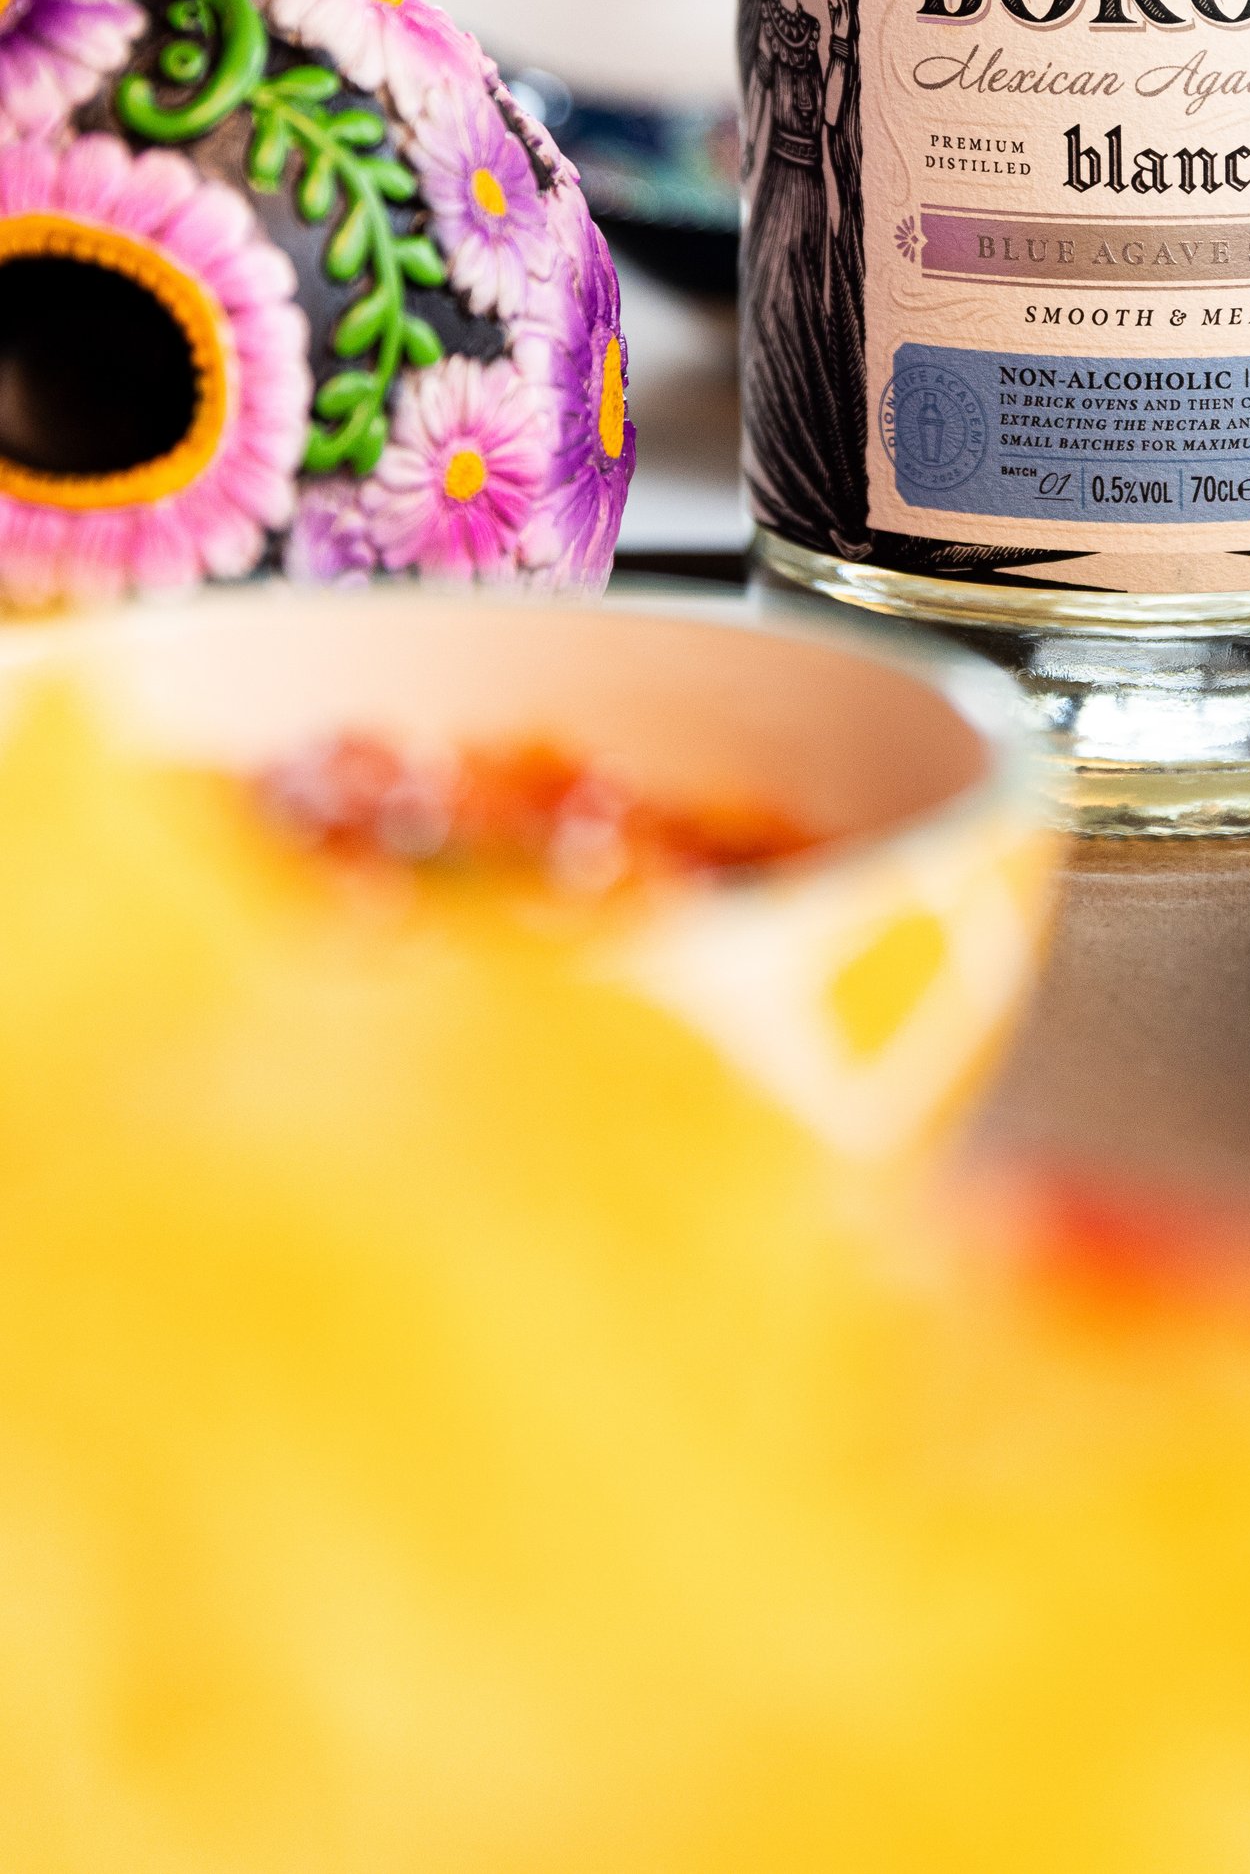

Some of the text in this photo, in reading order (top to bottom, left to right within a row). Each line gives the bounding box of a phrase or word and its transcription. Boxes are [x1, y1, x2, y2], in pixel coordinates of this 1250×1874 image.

[913, 44, 1125, 97] Mexican
[930, 134, 1025, 154] PREMIUM
[925, 155, 1031, 176] DISTILLED
[977, 234, 1076, 264] BLUE
[1092, 239, 1231, 266] AGAVE
[1024, 305, 1154, 327] SMOOTH
[1169, 308, 1187, 327] &
[999, 366, 1232, 391] NON-ALCOHOLIC
[1000, 393, 1017, 406] IN
[1023, 395, 1076, 410] BRICK
[1082, 398, 1138, 411] OVENS
[1144, 399, 1181, 411] AND
[1188, 397, 1235, 411] THEN
[935, 374, 982, 459] ACADEMY
[1000, 413, 1107, 431] EXTRACTING
[1114, 419, 1146, 431] THE
[1152, 418, 1220, 431] NECTAR
[1000, 433, 1053, 449] SMALL
[1059, 437, 1135, 451] BATCHES
[1142, 439, 1177, 451] FOR
[1001, 466, 1072, 495] BATCH 01
